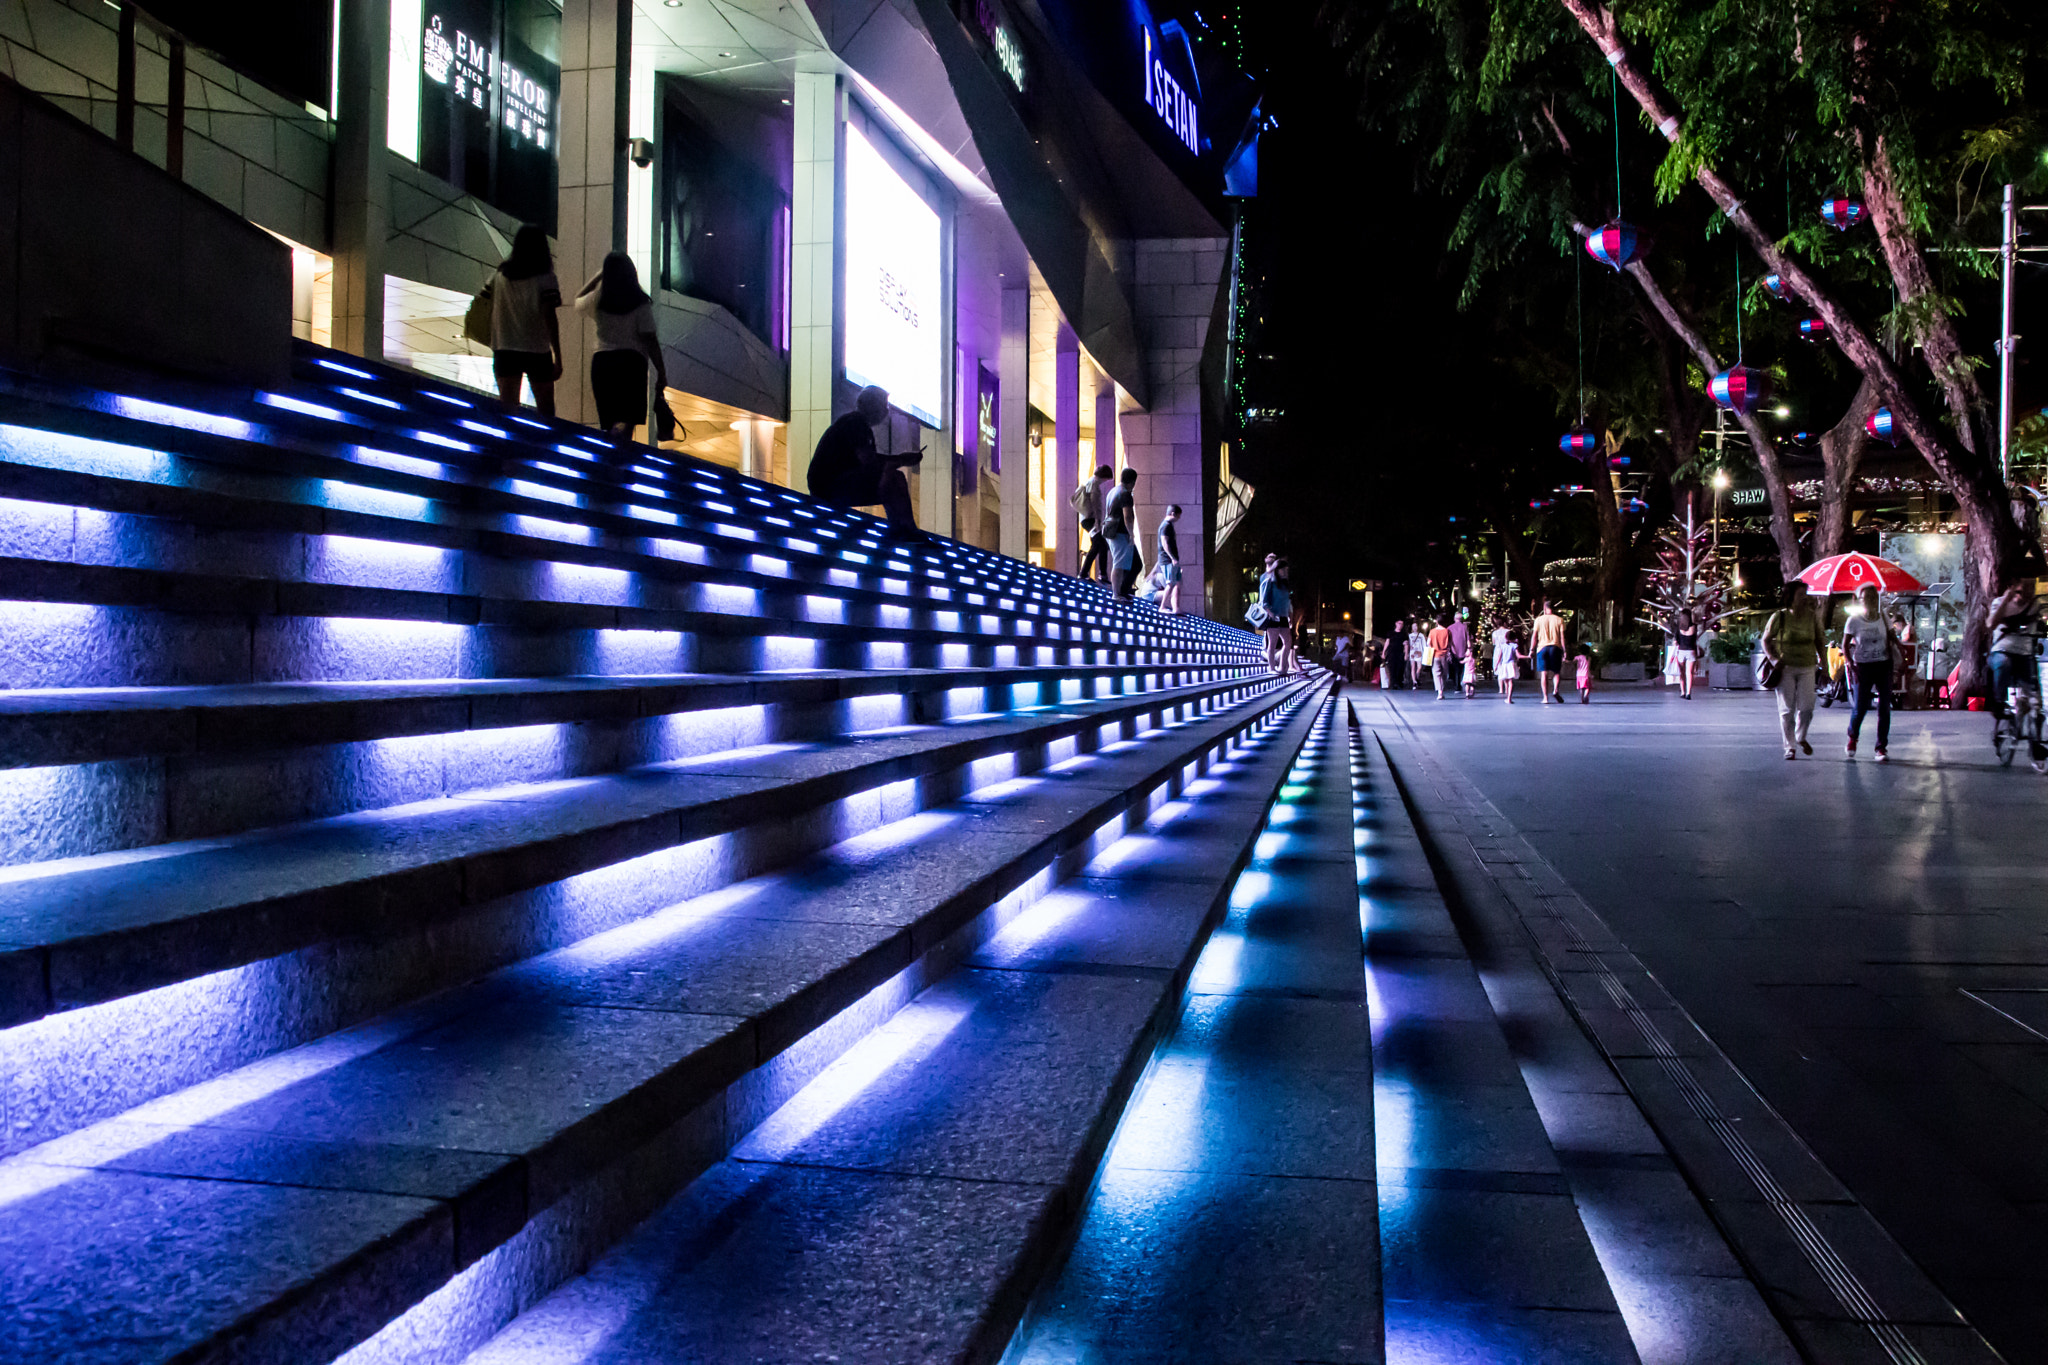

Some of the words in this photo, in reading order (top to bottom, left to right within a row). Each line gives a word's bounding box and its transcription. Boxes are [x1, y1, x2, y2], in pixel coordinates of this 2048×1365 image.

[455, 60, 482, 86] WATCH
[506, 94, 547, 127] JEWELLERY
[456, 30, 546, 114] EMEROR
[1144, 24, 1198, 156] ISETAN
[1732, 489, 1765, 505] SHAW
